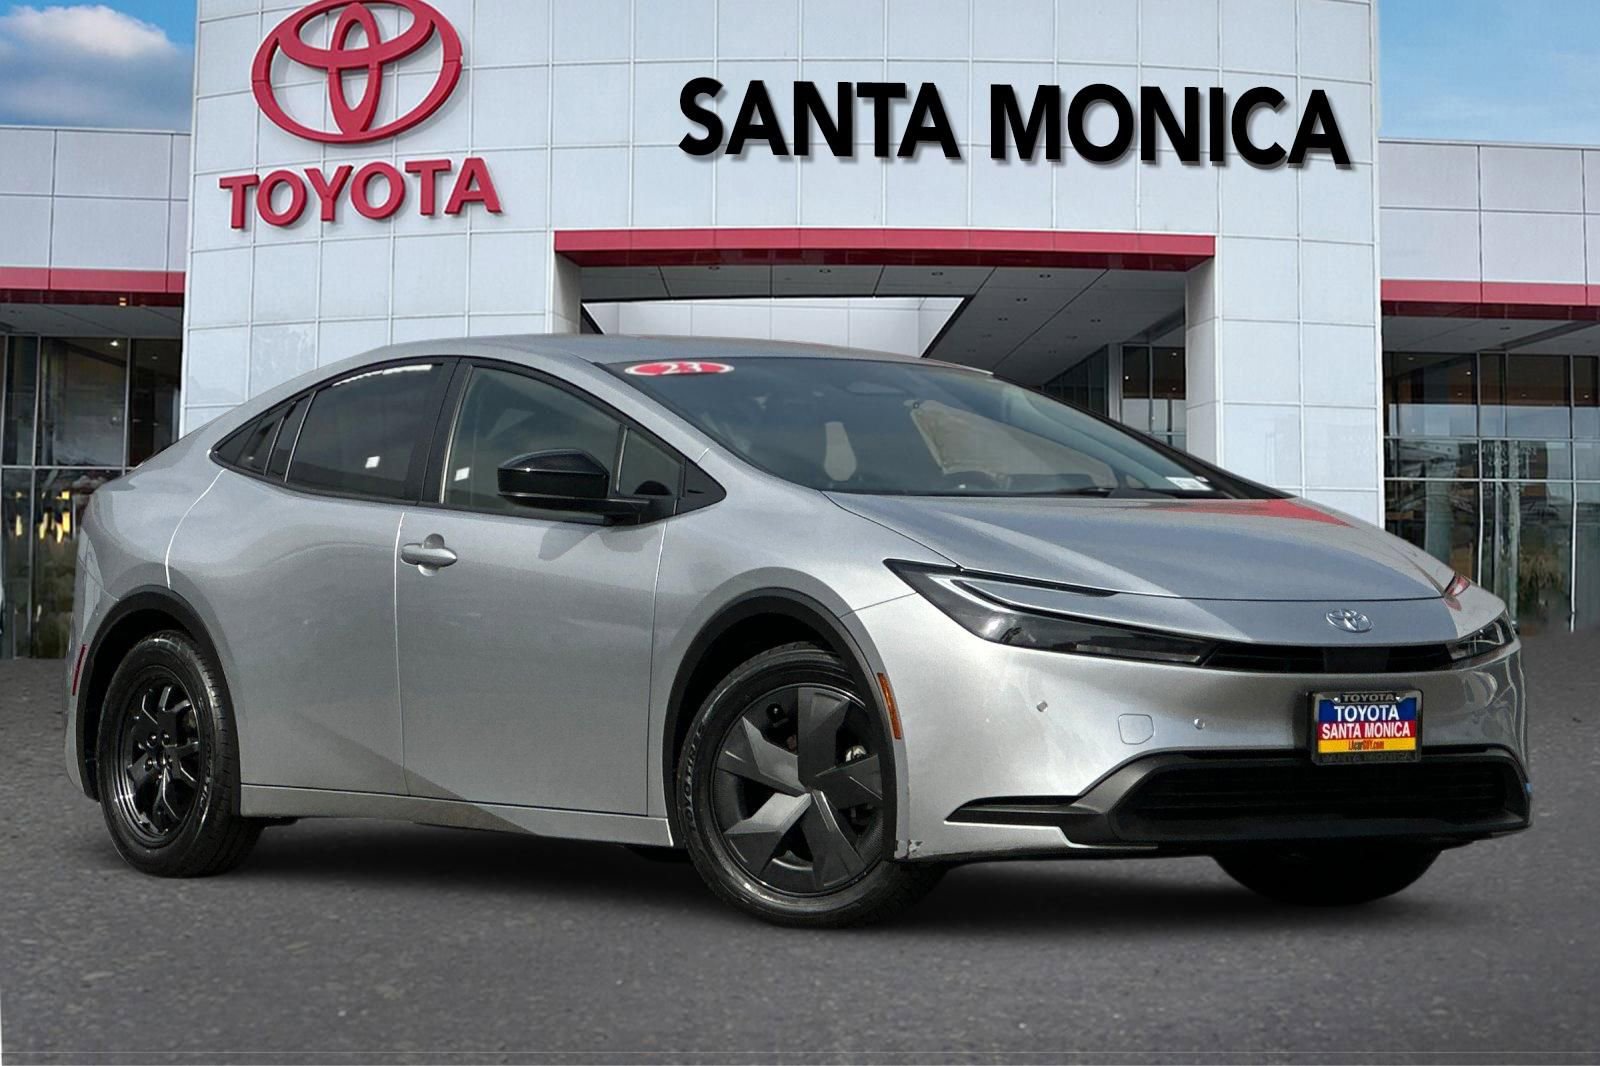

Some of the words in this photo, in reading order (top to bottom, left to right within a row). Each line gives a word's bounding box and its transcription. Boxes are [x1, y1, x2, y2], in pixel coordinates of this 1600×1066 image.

[678, 77, 962, 161] SANTA
[990, 83, 1353, 169] MONICA
[219, 157, 503, 230] TOYOTA
[661, 361, 703, 375] 23
[1343, 693, 1395, 703] TOYOTA
[1333, 704, 1400, 722] TOYOTA
[1322, 722, 1361, 739] SANTA
[1364, 721, 1411, 738] MONICA
